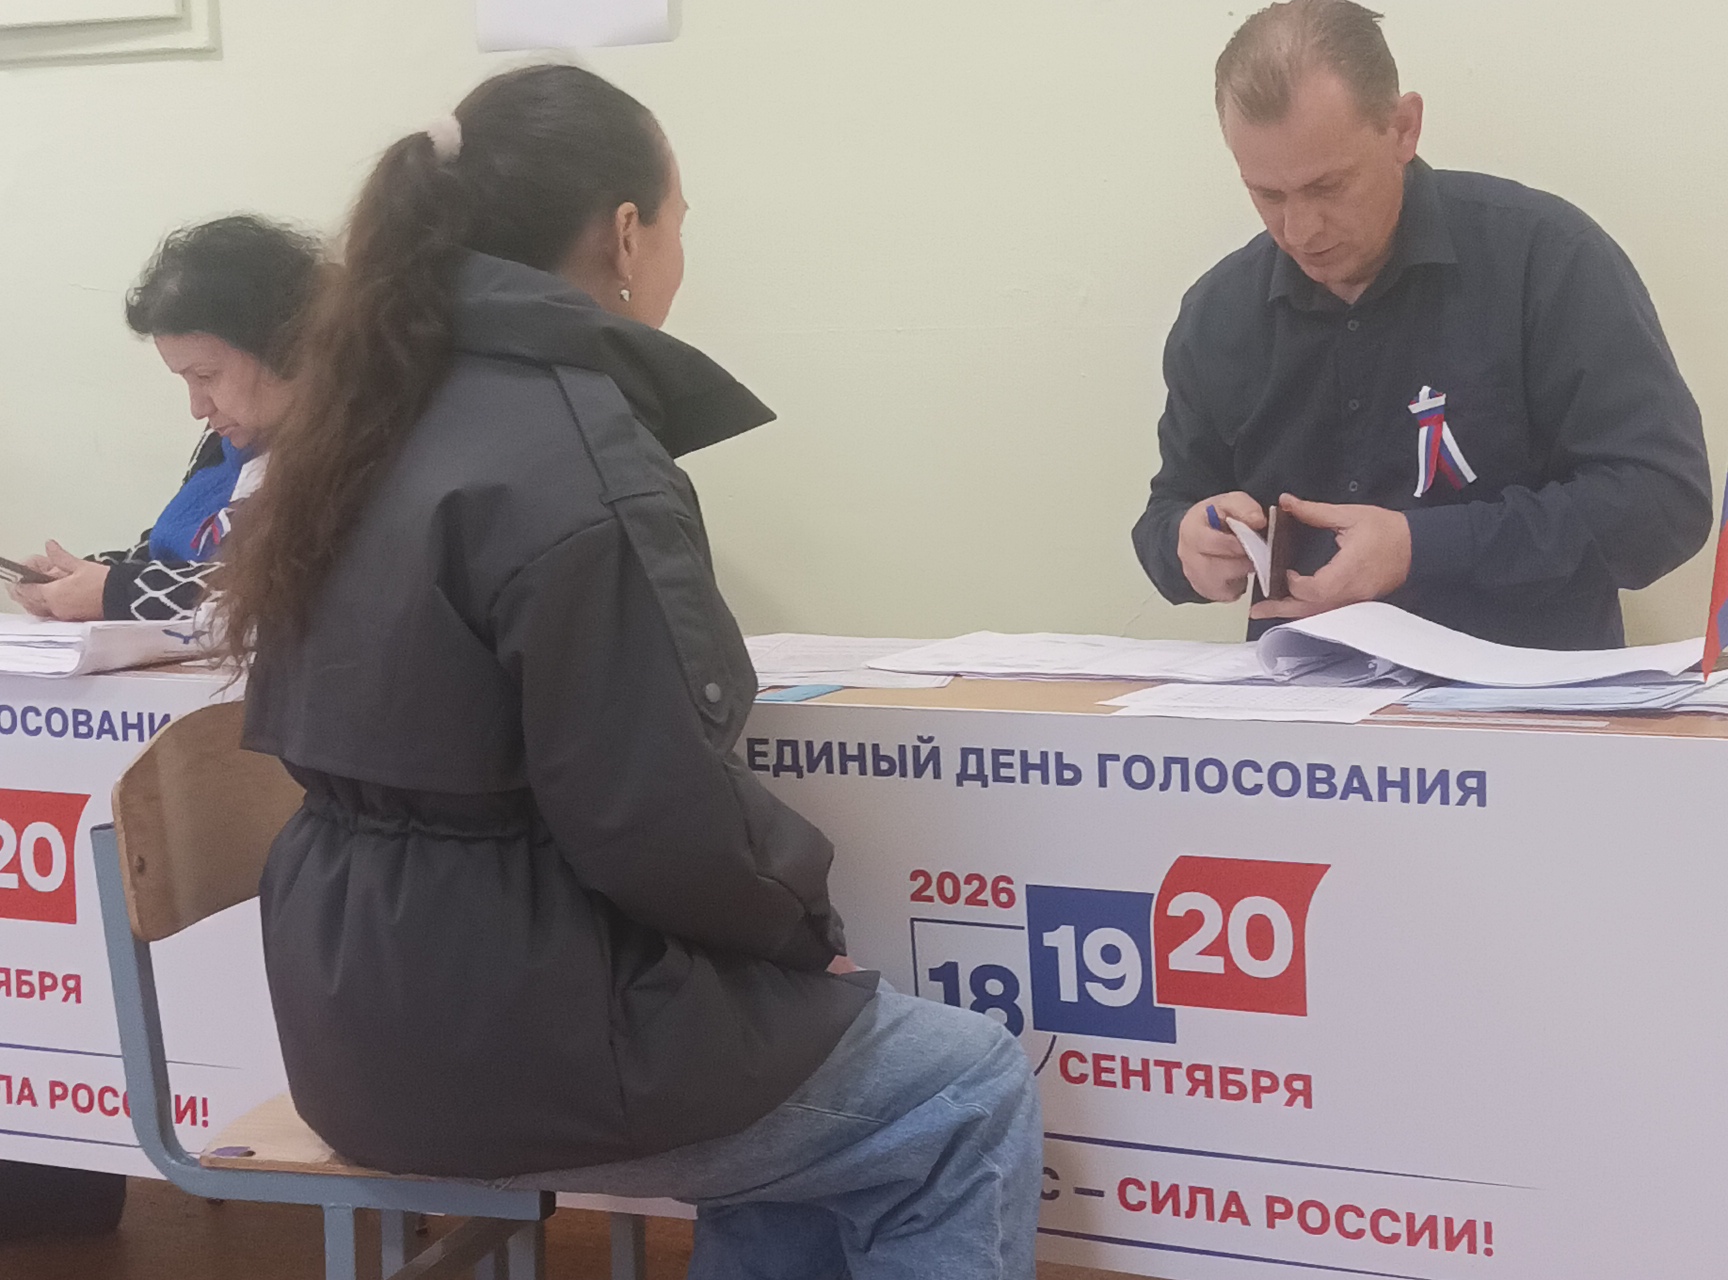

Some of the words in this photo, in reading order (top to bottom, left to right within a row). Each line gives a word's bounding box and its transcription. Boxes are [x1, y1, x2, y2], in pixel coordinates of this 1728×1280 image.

[746, 734, 942, 780] ЕДИНЫЙ
[956, 747, 1083, 788] ДЕНЬ
[1097, 752, 1488, 808] ГОЛОСОВАНИЯ
[909, 869, 1016, 909] 2026
[928, 961, 1025, 1038] 18
[1042, 924, 1143, 1008] 19
[1166, 891, 1294, 979] 20
[1059, 1049, 1314, 1110] СЕНТЯБРЯ
[1116, 1176, 1252, 1227] СИЛА
[1266, 1194, 1495, 1258] РОССИИ!
